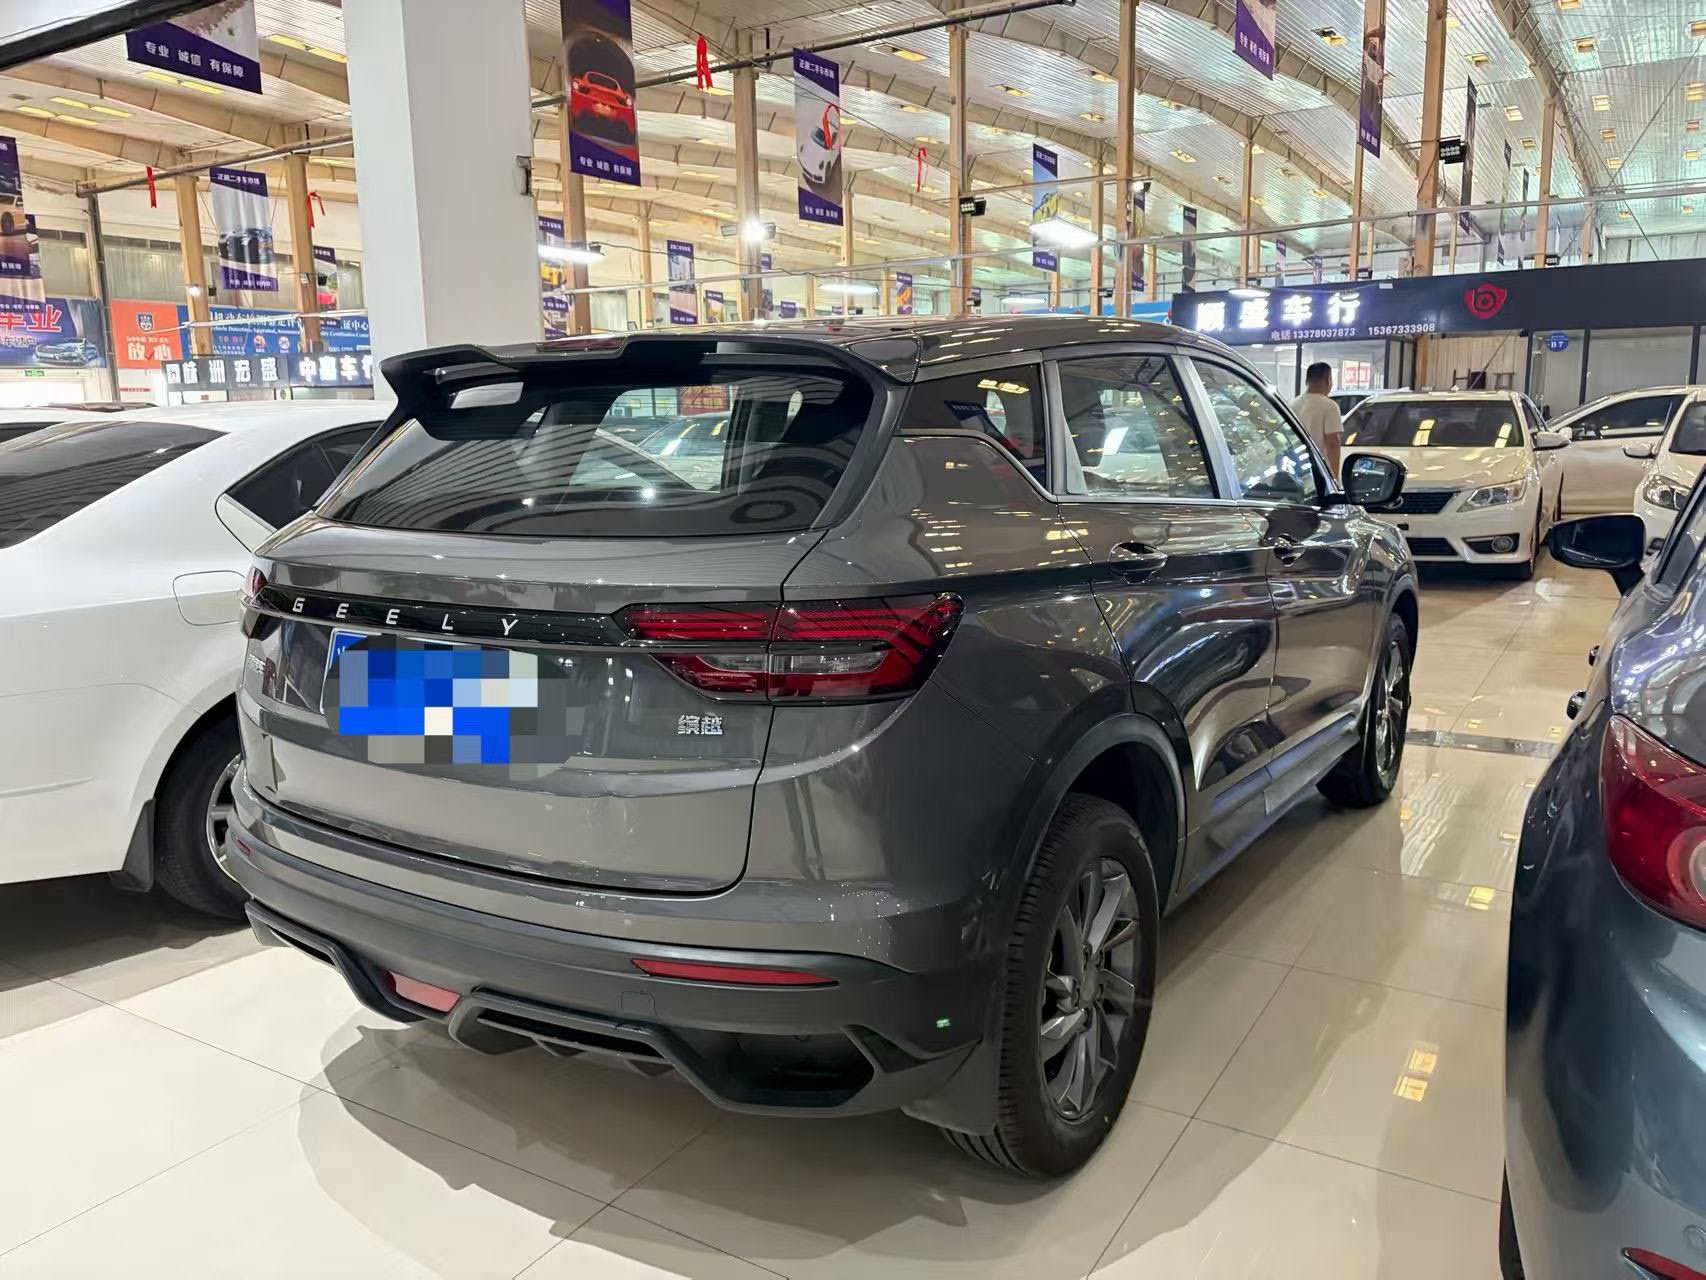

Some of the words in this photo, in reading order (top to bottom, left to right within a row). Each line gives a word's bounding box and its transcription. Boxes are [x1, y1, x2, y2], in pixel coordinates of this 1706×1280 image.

[145, 41, 170, 58] 专业
[177, 50, 202, 67] 诚信
[209, 58, 245, 78] 有保障
[1271, 330, 1291, 341] 电话
[1293, 327, 1356, 340] 13378037873
[1368, 323, 1436, 336] 15367333908
[292, 597, 519, 636] GEELY
[677, 714, 723, 735] 缤越
